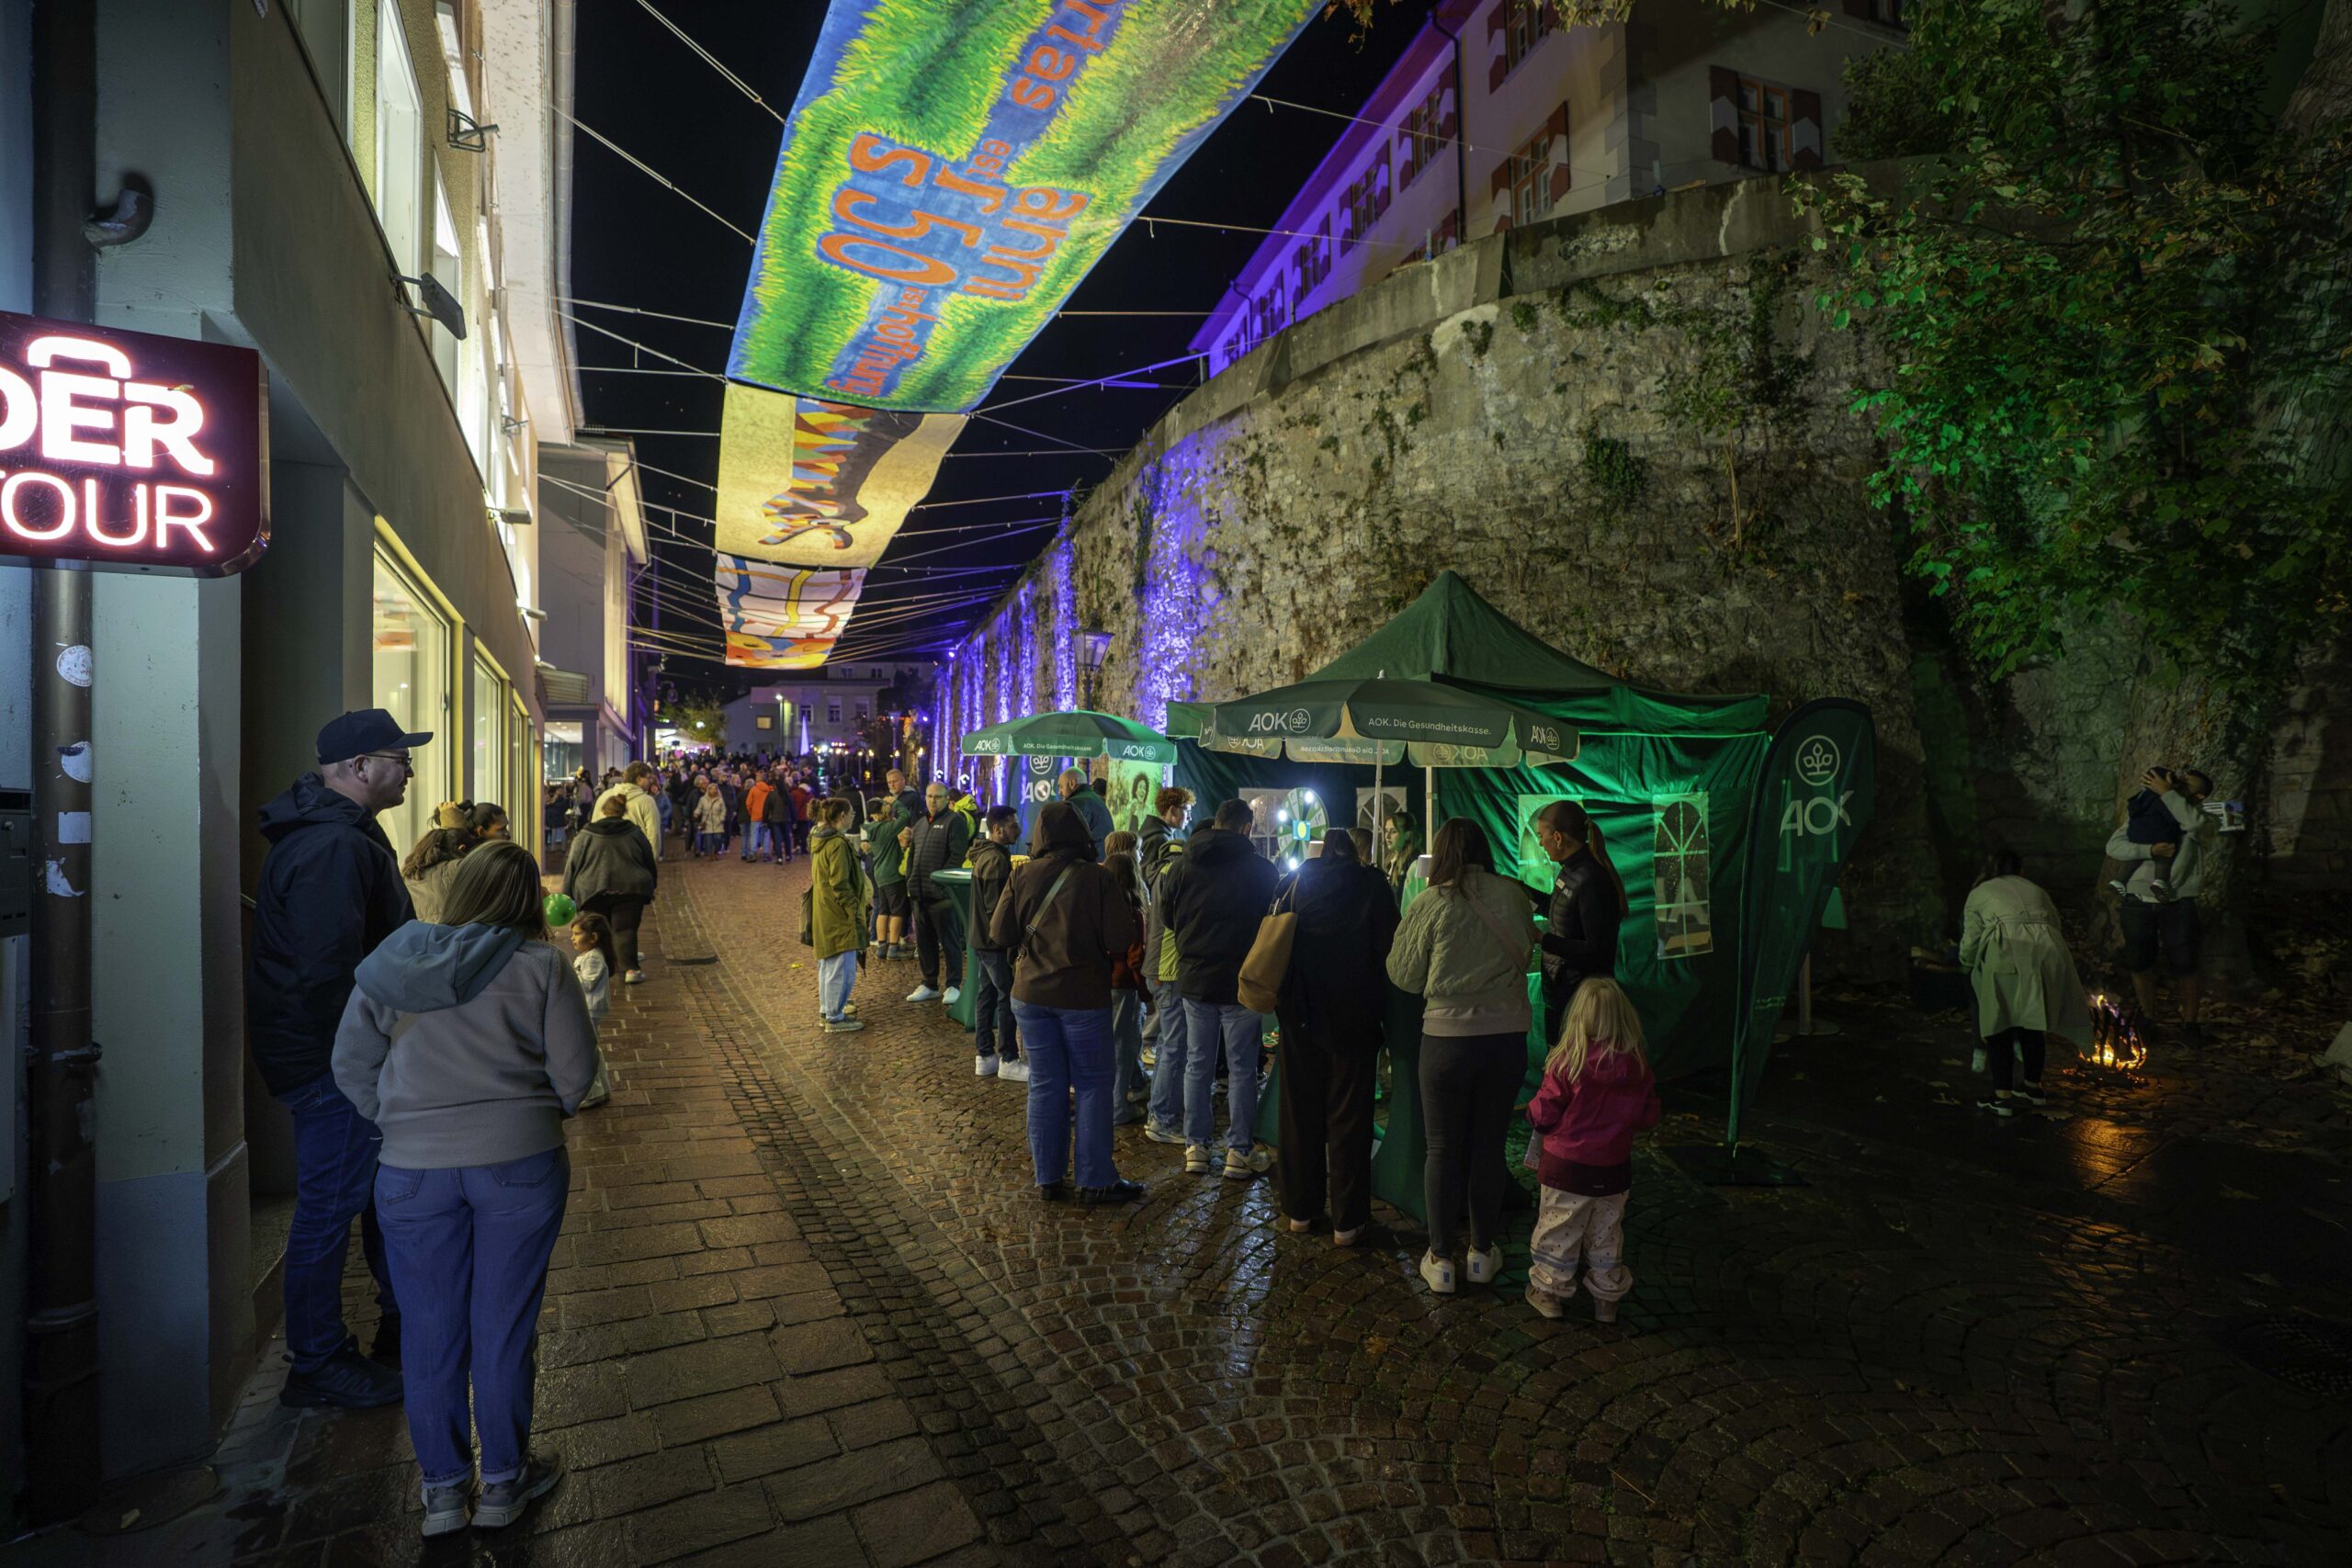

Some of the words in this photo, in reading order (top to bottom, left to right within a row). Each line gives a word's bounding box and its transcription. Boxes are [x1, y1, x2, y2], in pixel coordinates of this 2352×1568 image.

[1012, 0, 1118, 110] rtas
[963, 187, 1089, 301] anni
[0, 470, 214, 552] OUR
[1249, 711, 1287, 732] AOK
[1368, 718, 1391, 727] AOK.
[1393, 719, 1407, 728] Die
[1408, 720, 1491, 735] Gesundheitskasse.
[975, 739, 991, 750] AOK
[1123, 745, 1145, 757] AOK
